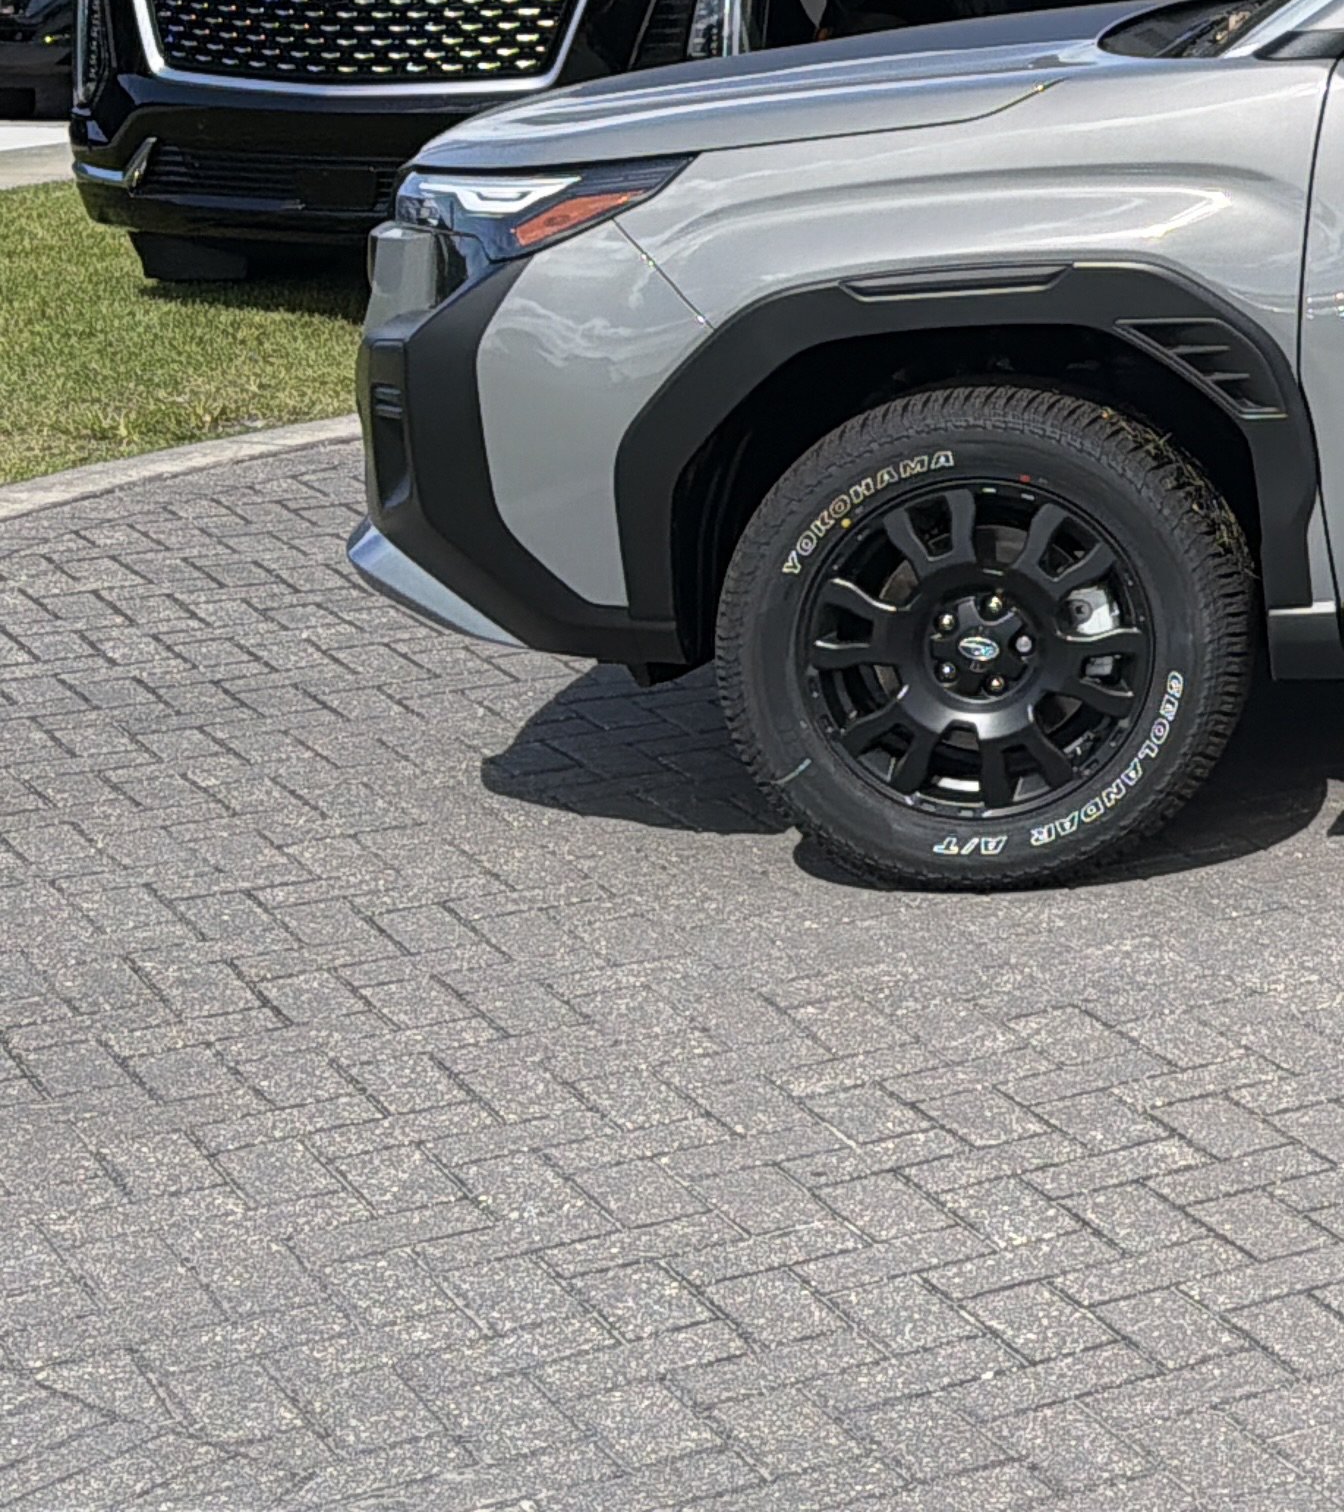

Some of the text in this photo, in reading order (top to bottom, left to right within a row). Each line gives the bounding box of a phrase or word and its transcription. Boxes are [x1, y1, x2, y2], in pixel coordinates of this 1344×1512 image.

[782, 450, 955, 576] YOKOHAMA
[933, 670, 1185, 857] GEOLANDAR A/T
